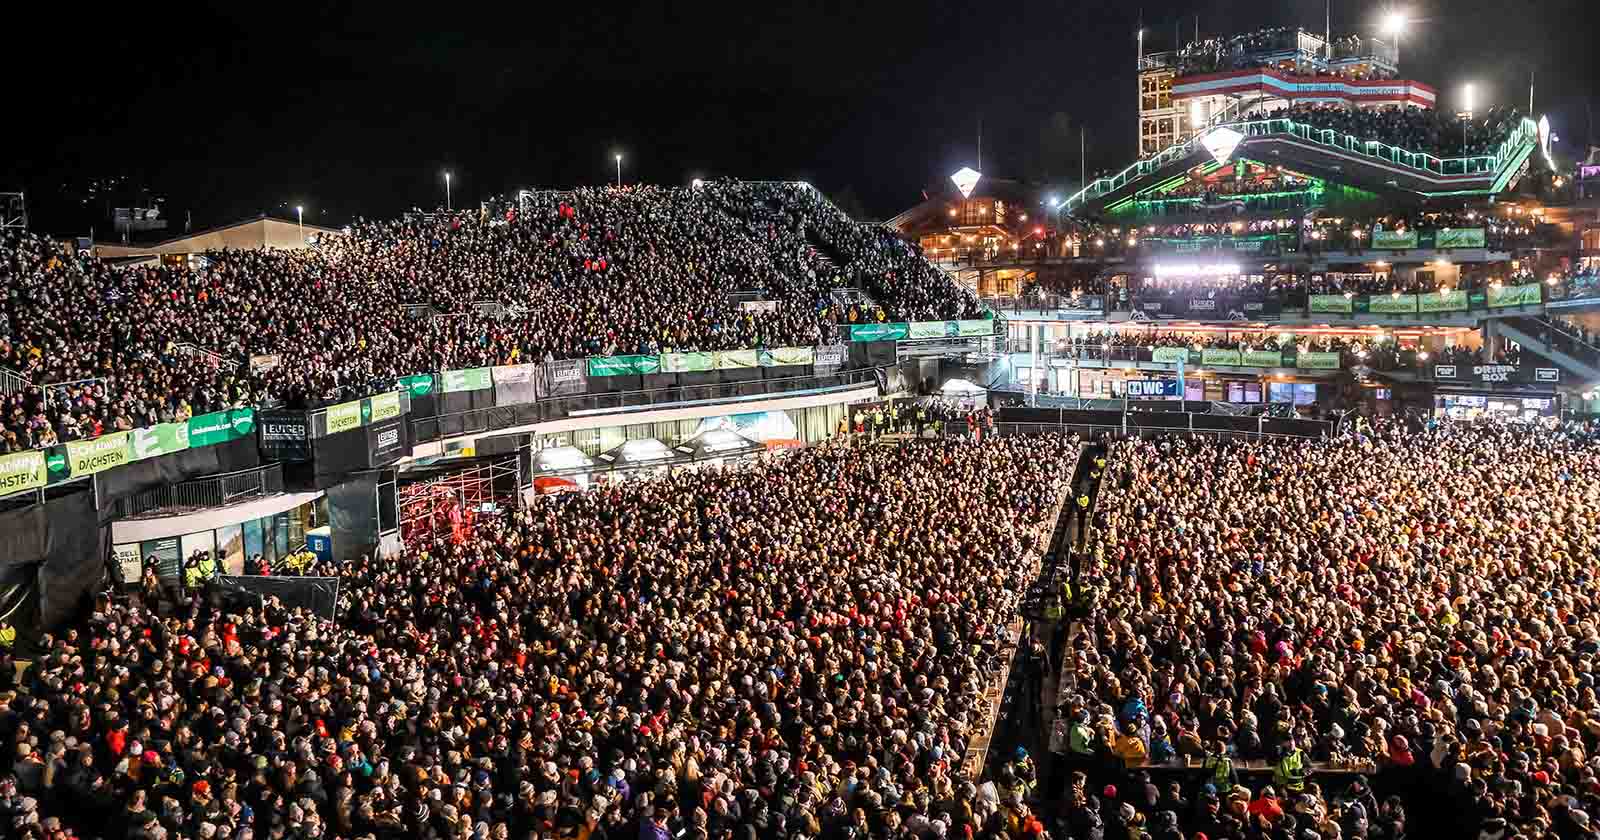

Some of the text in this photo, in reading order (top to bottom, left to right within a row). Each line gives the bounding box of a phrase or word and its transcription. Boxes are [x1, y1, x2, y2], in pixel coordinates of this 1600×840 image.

[1482, 373, 1508, 381] BOX
[1143, 381, 1164, 395] WC
[263, 424, 306, 436] LEUTGEB
[79, 450, 123, 471] DACHSTEIN
